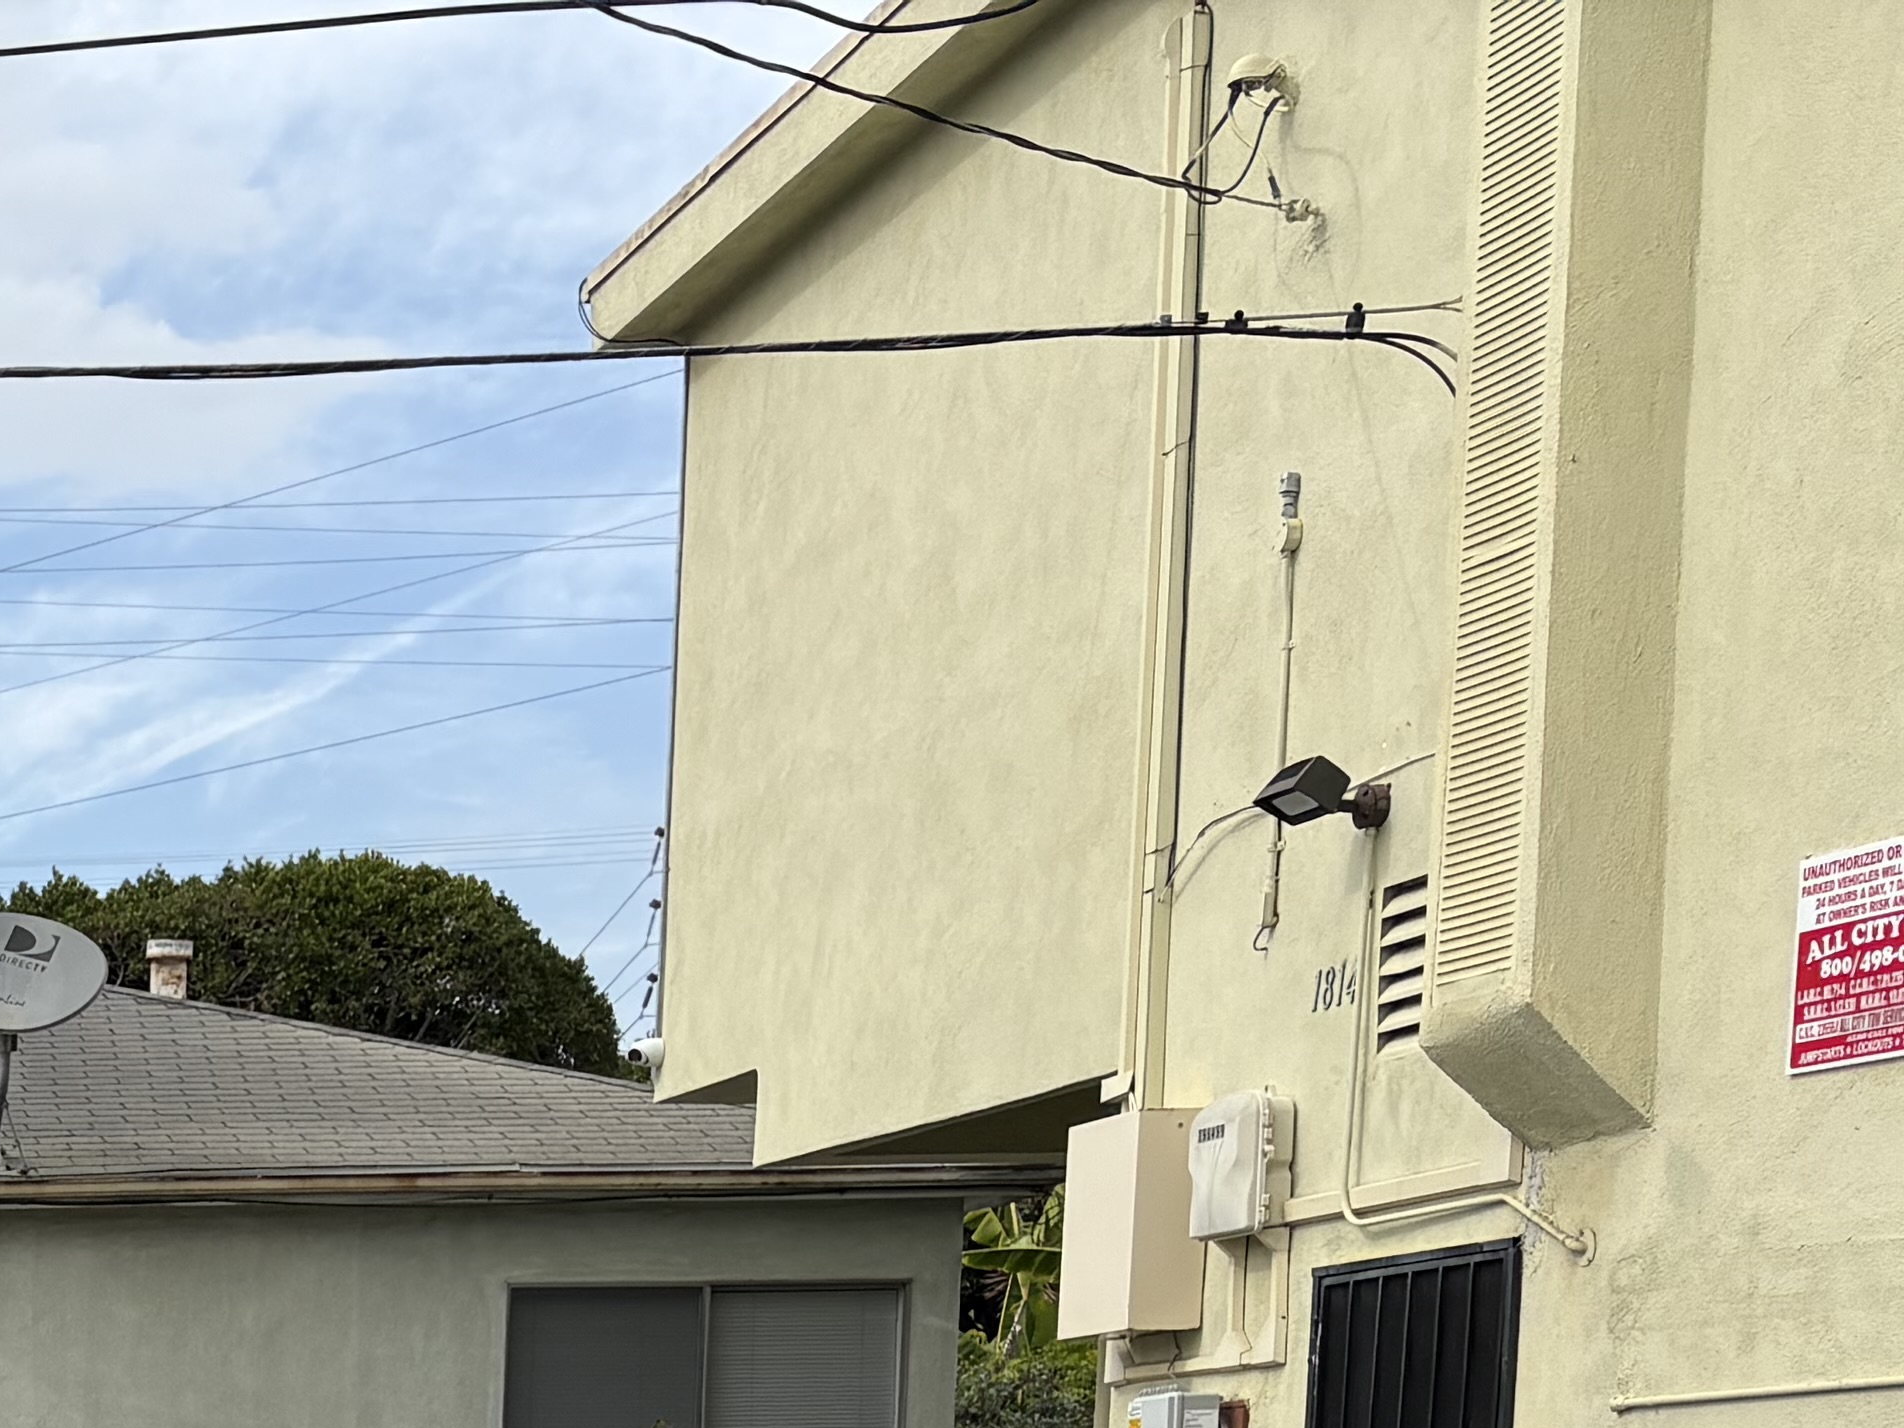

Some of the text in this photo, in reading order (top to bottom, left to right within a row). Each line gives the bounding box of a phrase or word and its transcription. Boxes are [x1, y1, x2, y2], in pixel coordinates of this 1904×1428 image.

[1803, 844, 1903, 881] UNAUTHORIZED OR
[1801, 863, 1903, 898] PARKED VEHICLES WILL
[1827, 890, 1858, 907] HOURS
[1869, 897, 1891, 912] RISK
[1806, 913, 1904, 965] ALL CITY
